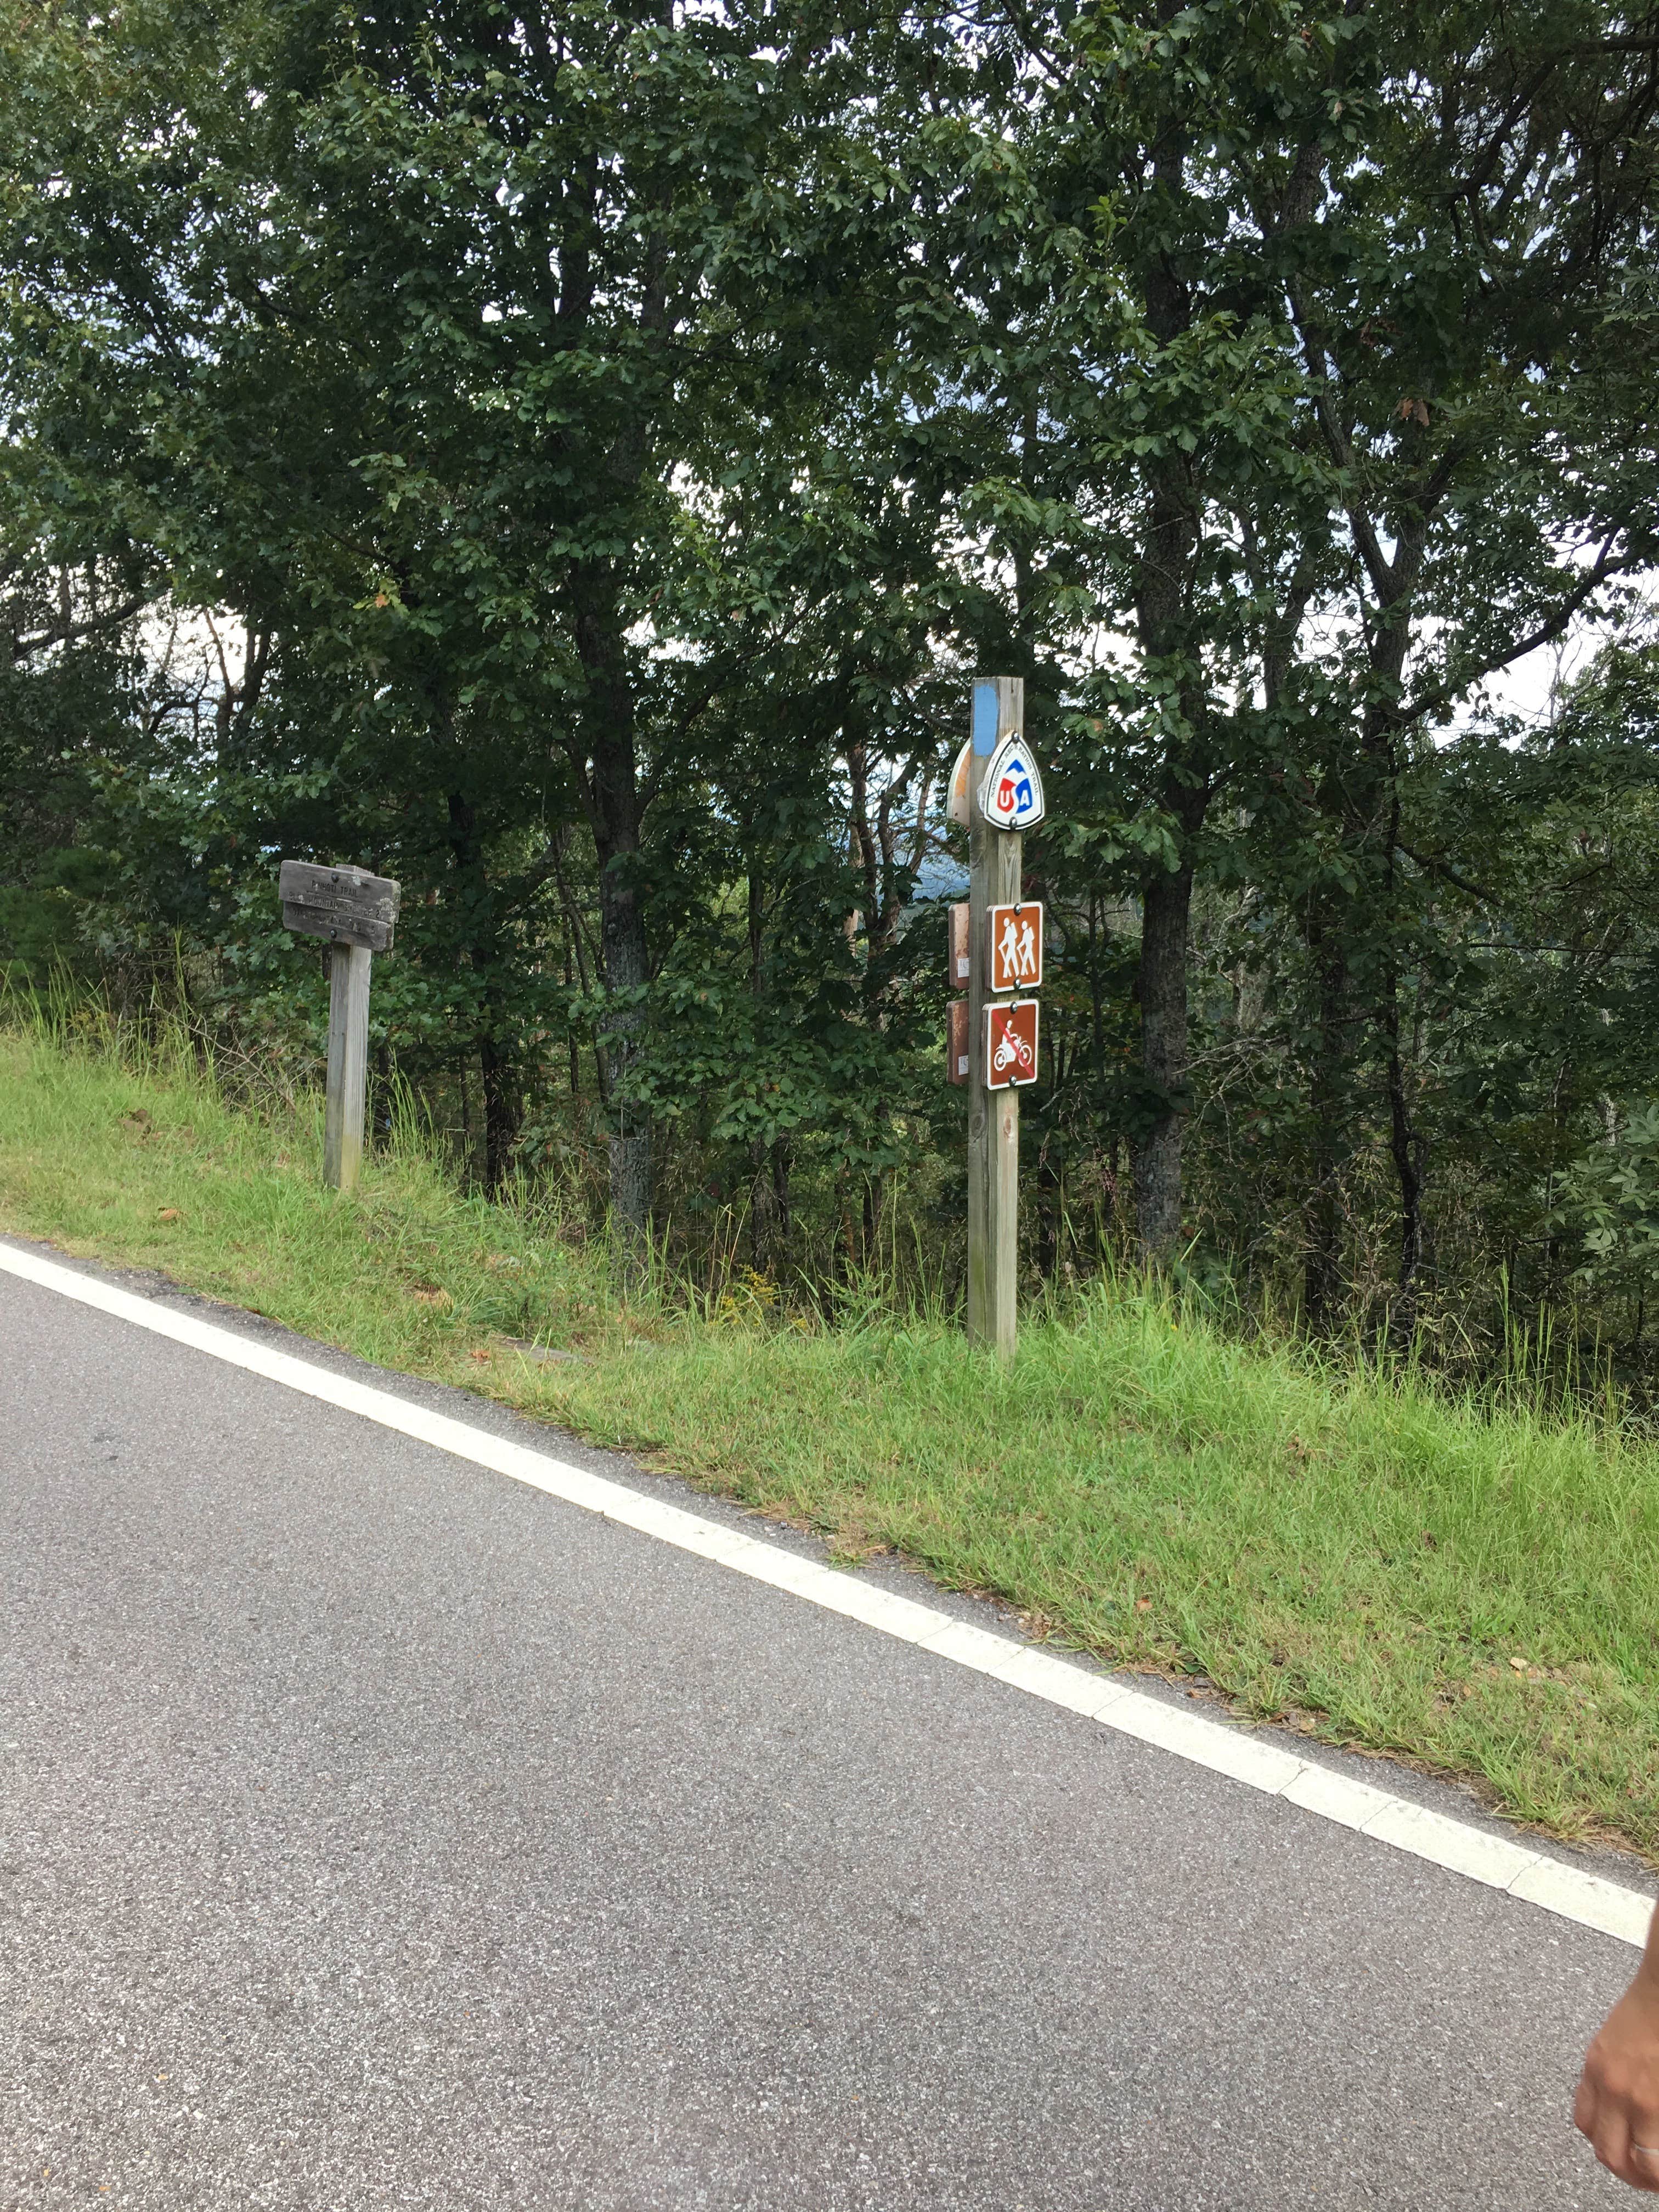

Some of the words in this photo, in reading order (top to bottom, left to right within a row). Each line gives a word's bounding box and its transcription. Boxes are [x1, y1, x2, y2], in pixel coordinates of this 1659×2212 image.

[991, 760, 1005, 798] NATIONAL
[1005, 744, 1032, 770] RECREATION
[999, 787, 1030, 810] USA
[340, 886, 358, 898] TRAIL
